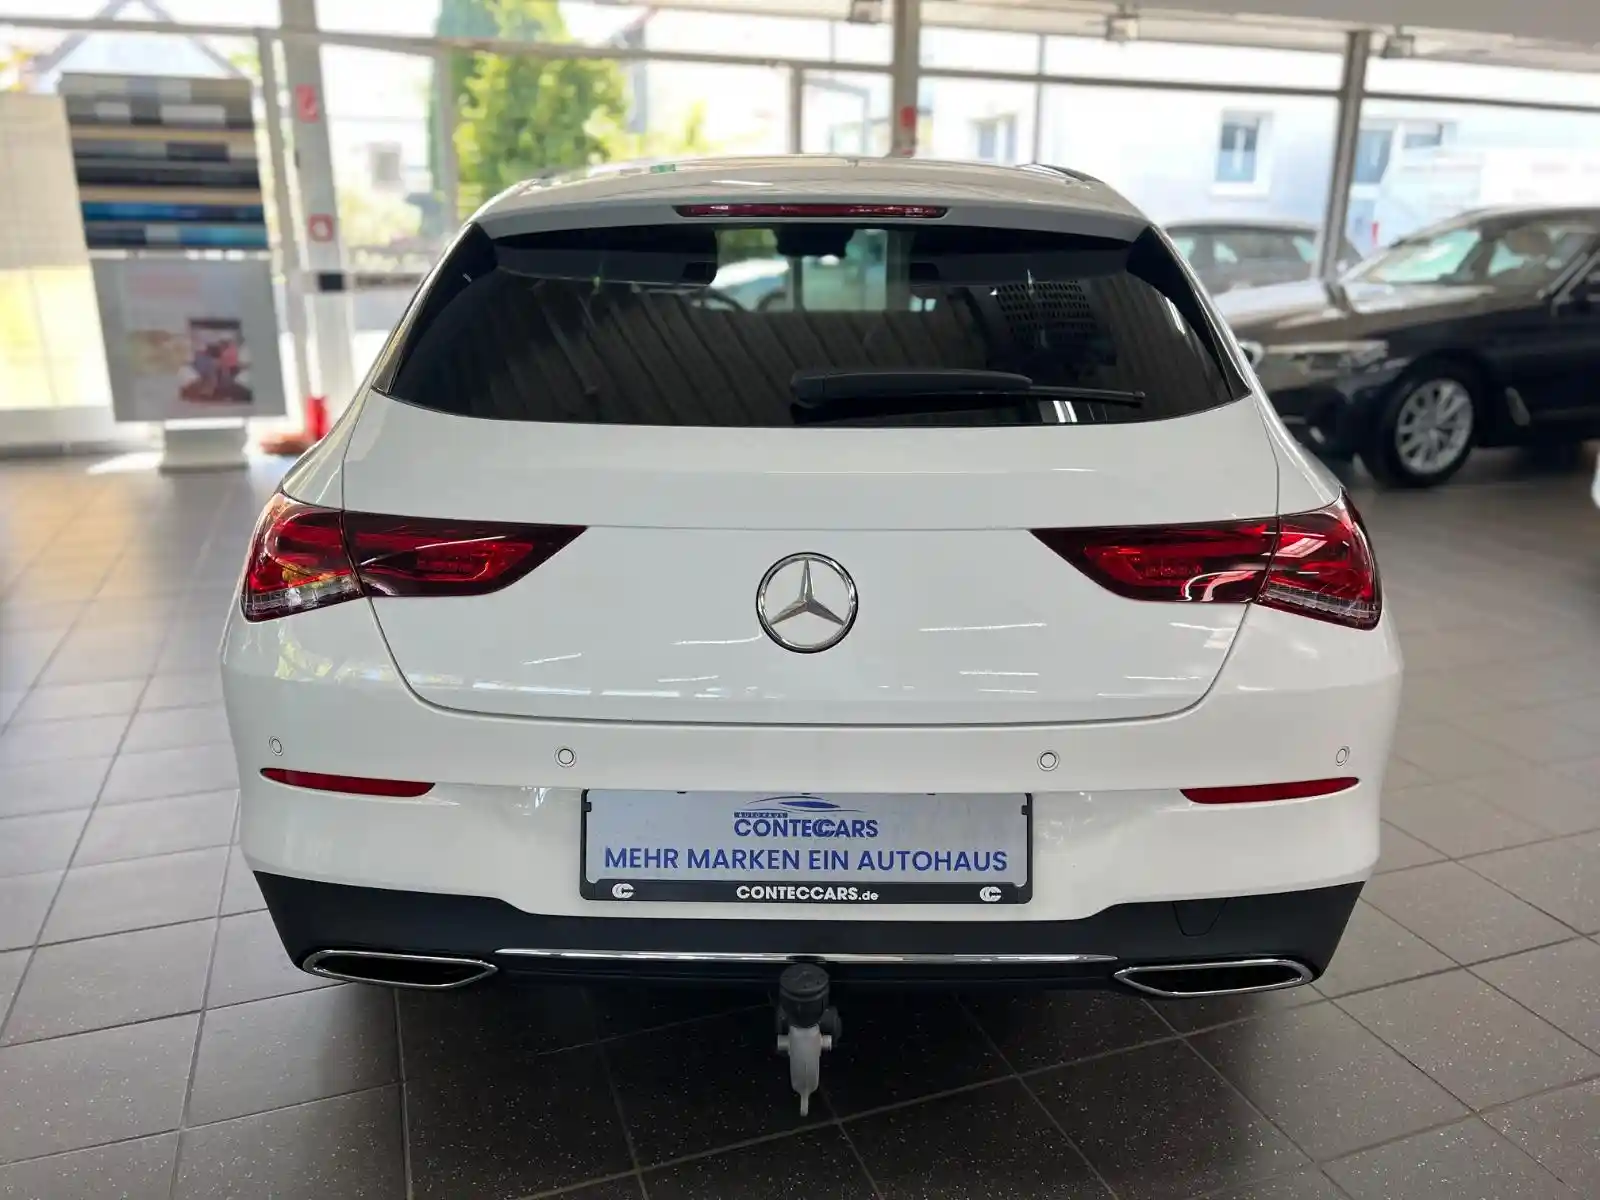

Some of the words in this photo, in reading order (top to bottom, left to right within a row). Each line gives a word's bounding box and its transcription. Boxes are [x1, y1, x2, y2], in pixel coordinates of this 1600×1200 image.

[734, 819, 878, 837] CONTECCARS
[605, 848, 678, 868] MEHR
[688, 849, 800, 869] MARKEN
[808, 850, 848, 870] EIN
[857, 851, 1007, 871] AUTOHAUS
[736, 886, 878, 901] CONTECCARS.de
